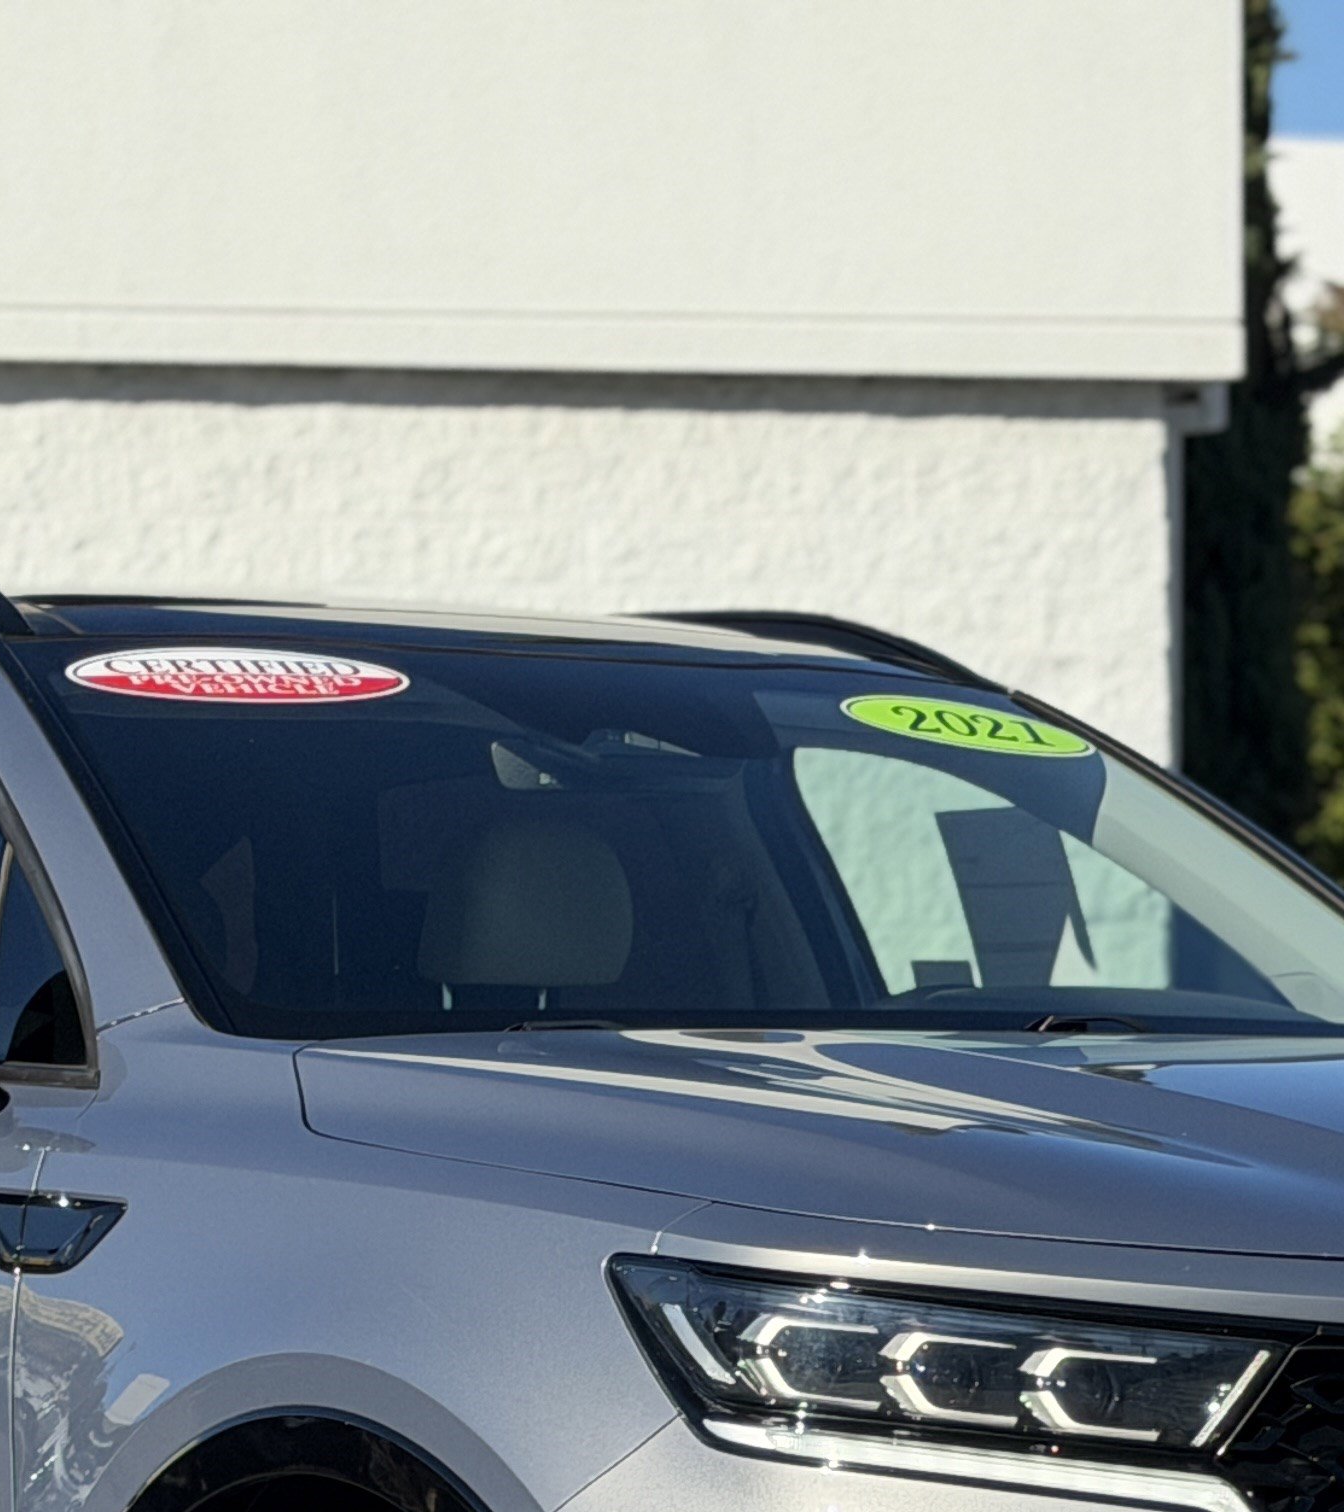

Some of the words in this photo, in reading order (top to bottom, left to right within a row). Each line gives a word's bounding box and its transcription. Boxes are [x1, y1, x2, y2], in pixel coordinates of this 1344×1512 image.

[105, 659, 362, 676] CERTIFIED
[128, 673, 362, 687] PRE-OWNED
[171, 682, 341, 695] VEHICLE
[890, 705, 1056, 748] 2021
